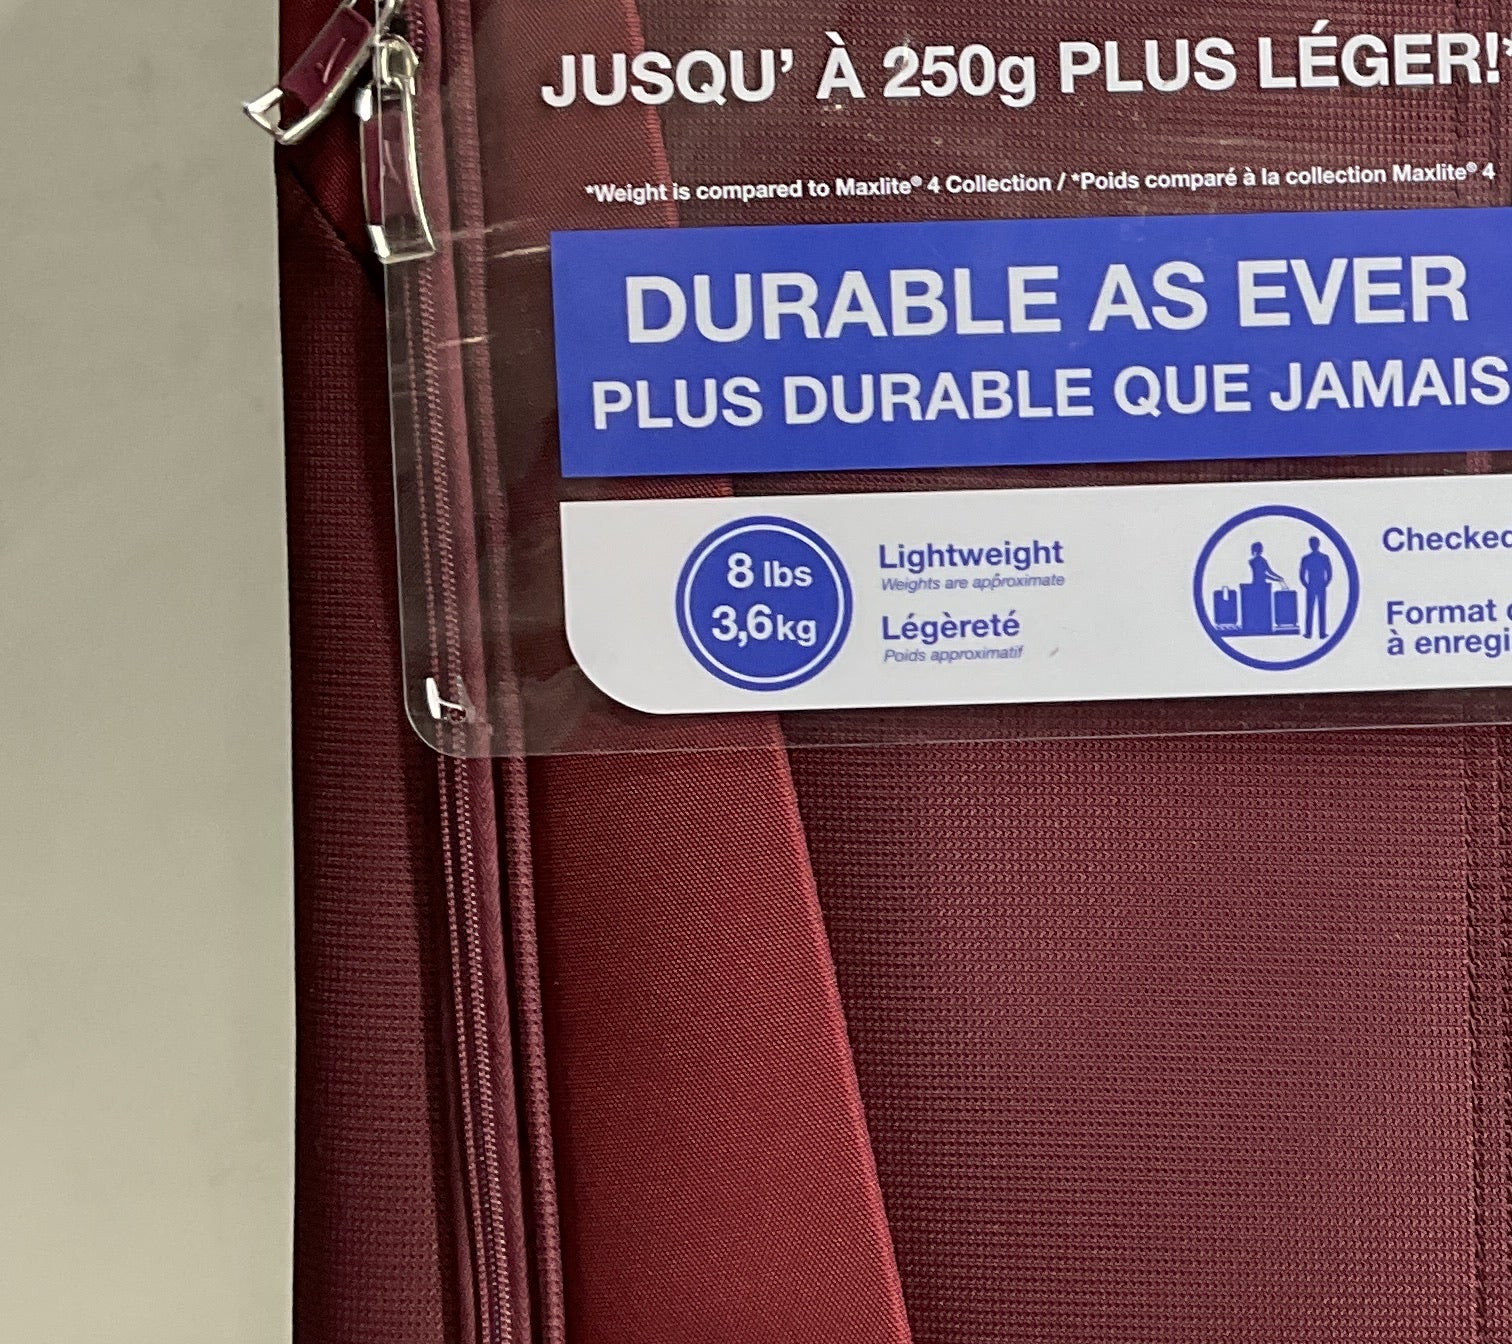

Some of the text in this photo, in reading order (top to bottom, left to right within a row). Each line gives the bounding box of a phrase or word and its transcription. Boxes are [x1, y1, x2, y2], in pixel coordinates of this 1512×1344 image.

[817, 33, 865, 102] À
[883, 44, 1036, 108] 250g
[1060, 38, 1238, 96] PLUS
[673, 182, 690, 201] is
[696, 179, 803, 203] compared
[808, 180, 830, 198] to
[927, 176, 940, 194] 4
[946, 174, 1052, 194] Collection
[1057, 171, 1066, 191] /
[1145, 167, 1236, 191] comparé
[1243, 167, 1256, 185] à
[1261, 167, 1279, 185] la
[1285, 165, 1387, 185] collection
[1482, 162, 1495, 180] 4
[626, 256, 1469, 346] DURABLE AS EVER
[592, 356, 1510, 431] PLUS DURABLE QUE JAMAIS
[727, 552, 813, 589] 8 lbs
[879, 539, 1064, 572] Lightweight
[881, 572, 1065, 593] Weights are approximate
[881, 611, 1020, 645] Légèreté
[1387, 597, 1498, 626] Format
[884, 644, 1024, 663] Poids approximatif
[1387, 628, 1404, 656] à
